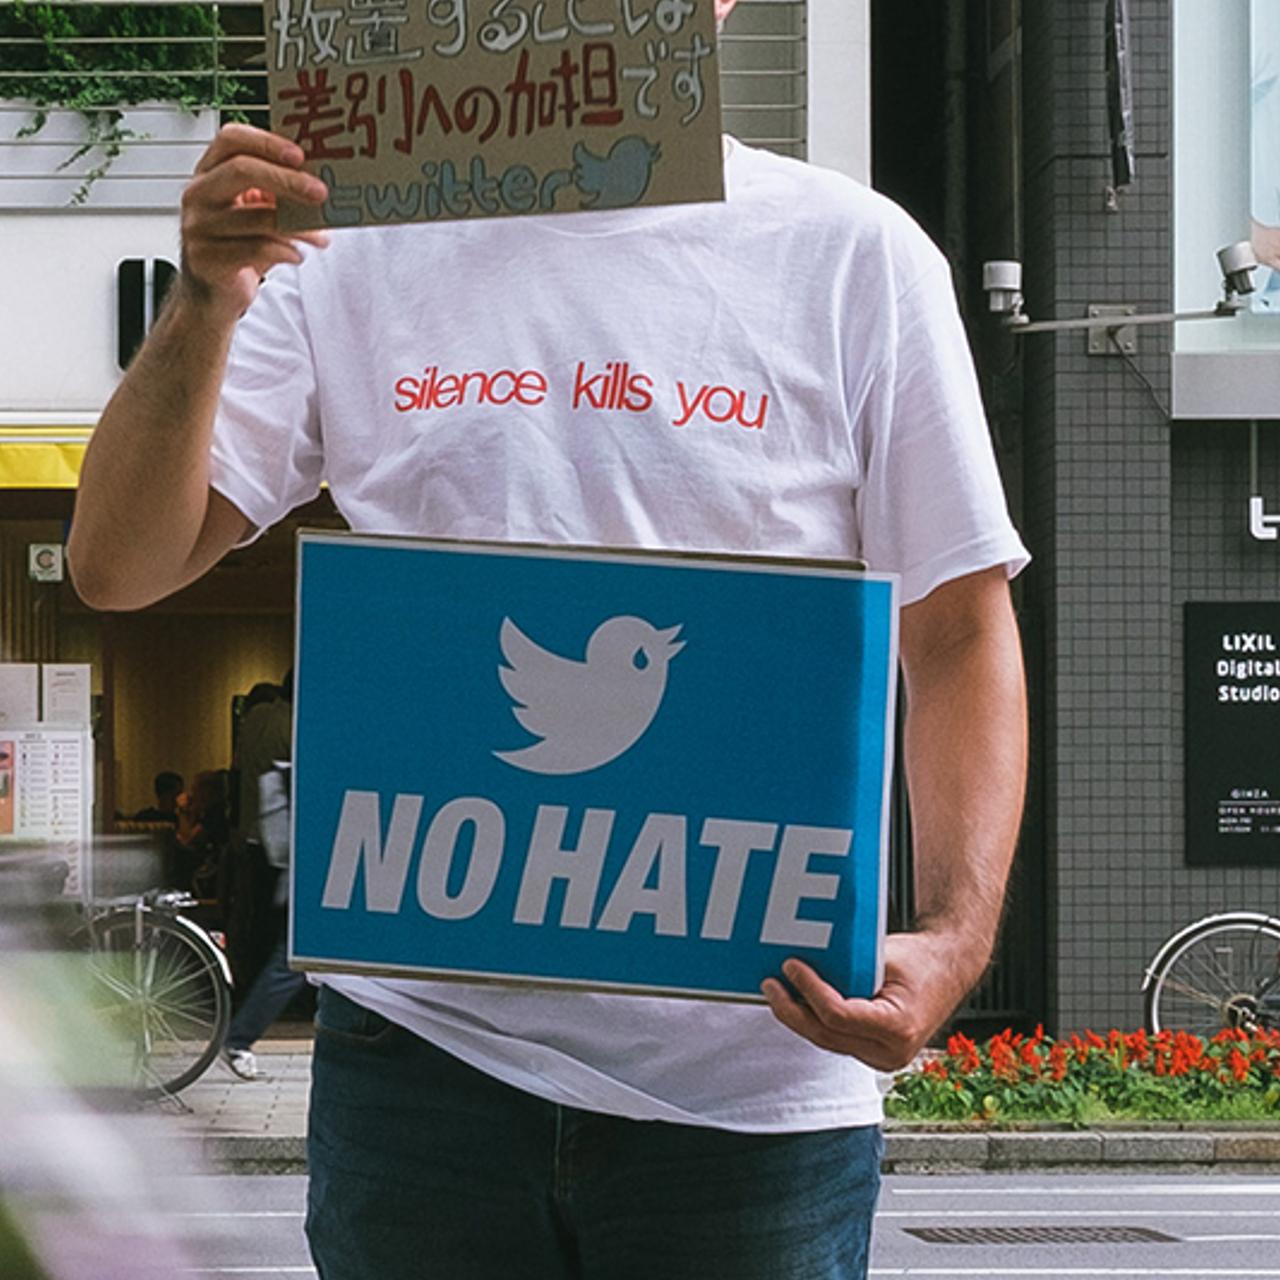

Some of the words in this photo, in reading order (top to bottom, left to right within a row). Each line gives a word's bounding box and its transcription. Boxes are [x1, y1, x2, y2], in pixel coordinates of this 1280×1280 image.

[278, 34, 716, 160] 差別への加担です
[320, 154, 576, 222] twitter
[395, 366, 548, 412] silence
[572, 361, 654, 412] kills
[672, 381, 769, 430] you
[1222, 633, 1276, 652] LIXIL
[1218, 684, 1280, 702] Studio
[1231, 788, 1270, 799] GINZA
[321, 789, 506, 921] NO
[512, 804, 854, 950] HATE
